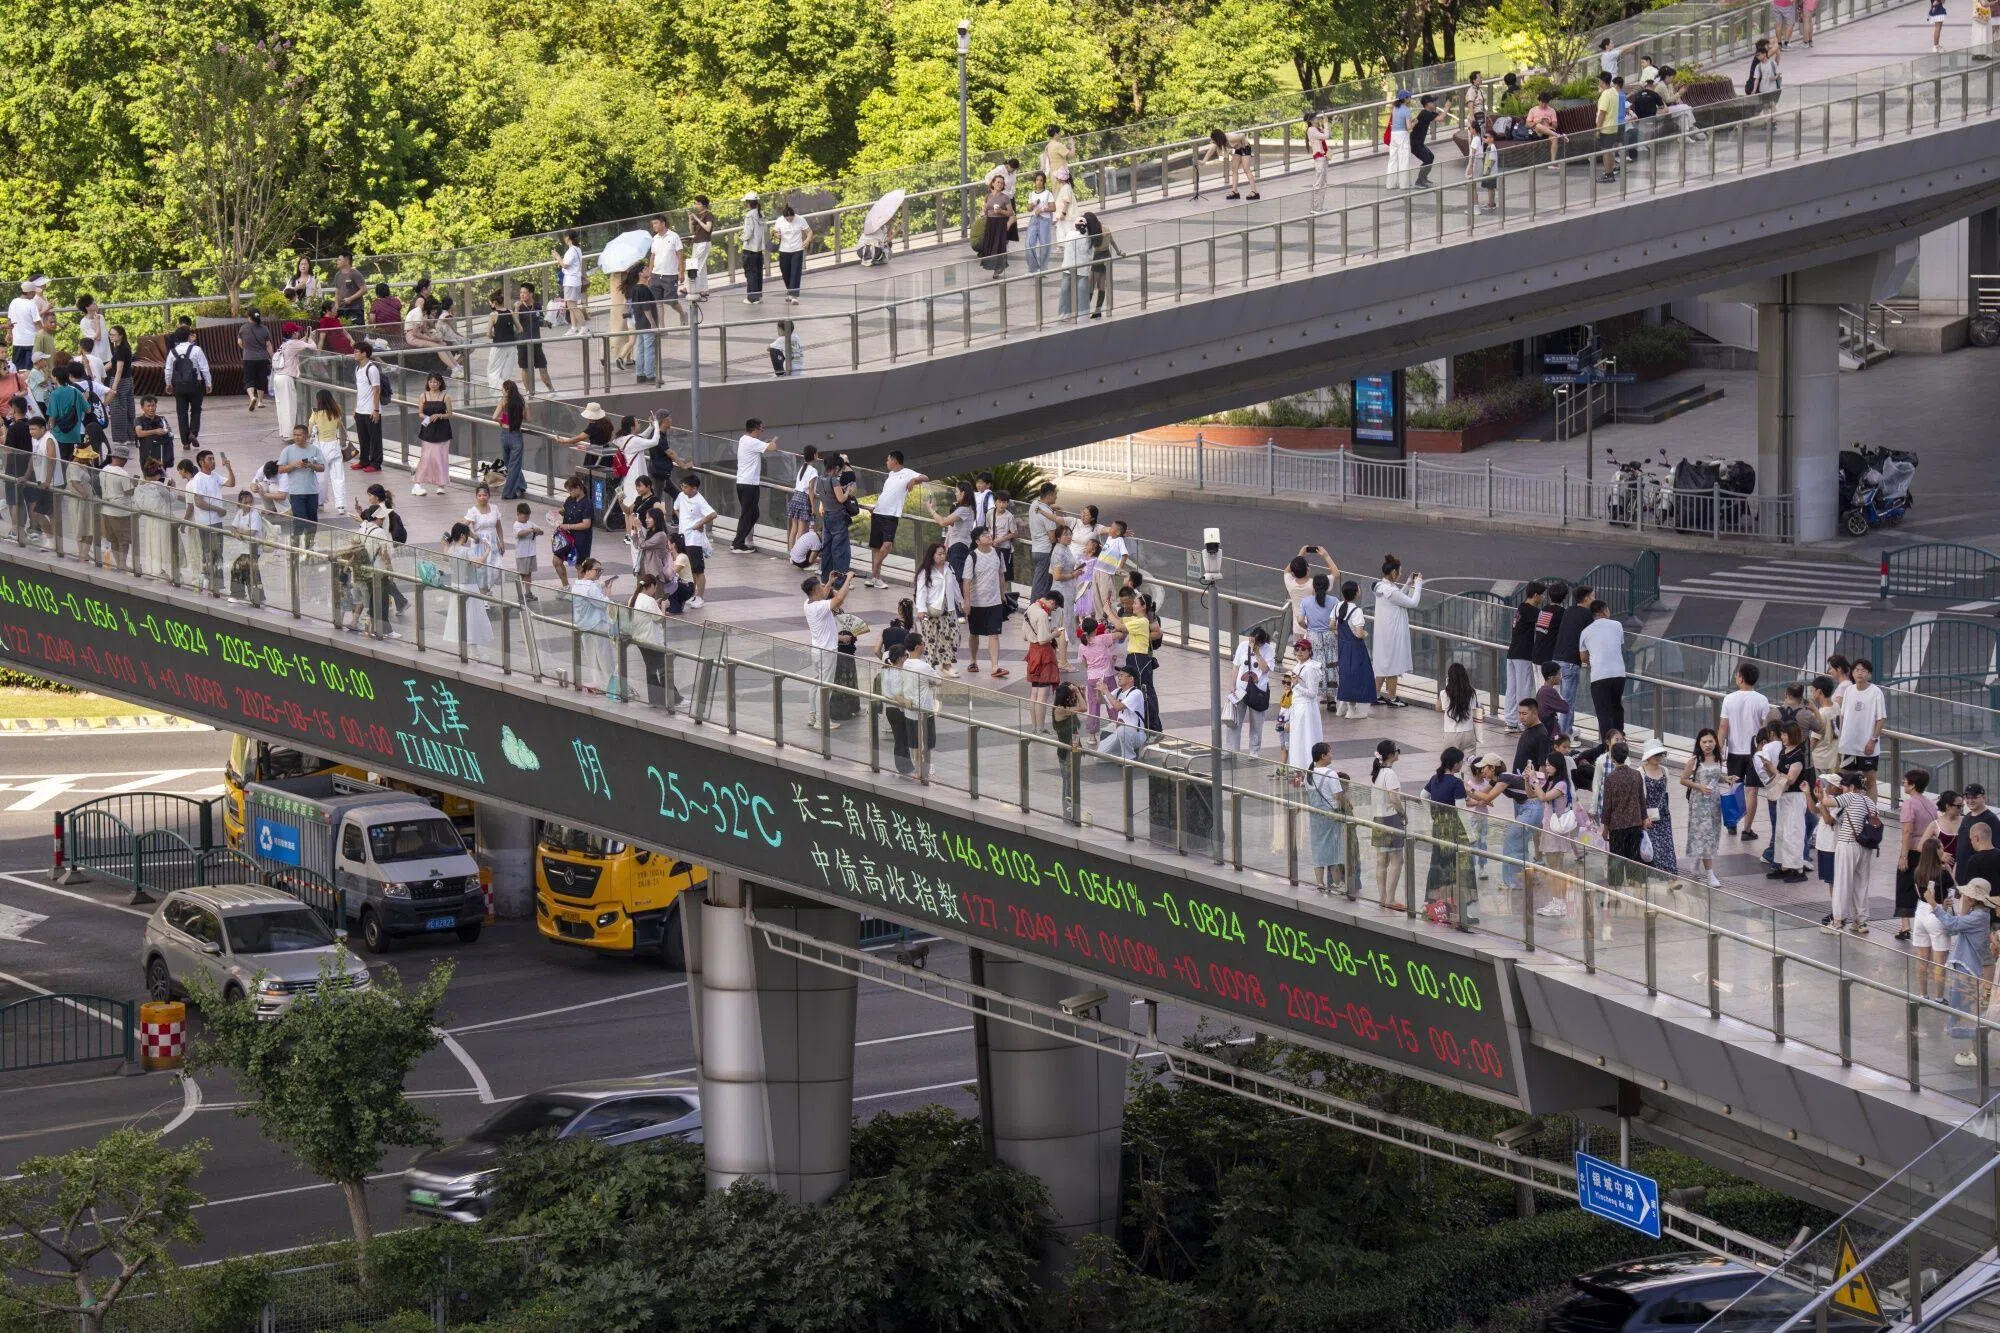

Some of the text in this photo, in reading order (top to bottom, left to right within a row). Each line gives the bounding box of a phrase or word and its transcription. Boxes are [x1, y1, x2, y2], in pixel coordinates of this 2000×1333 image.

[215, 632, 316, 686] 2025-08-15
[320, 660, 374, 701] 00:00
[236, 687, 336, 741] 2025-08-15
[339, 715, 394, 757] 00:00
[403, 679, 469, 746] 天津
[396, 731, 485, 785] TIANJIN
[572, 735, 612, 800] 阴
[1258, 919, 1398, 988] 2025-08-15
[1407, 961, 1482, 1012] 00:00
[1279, 982, 1419, 1054] 2025-08-15
[1428, 1026, 1503, 1080] 00:00
[1592, 1170, 1634, 1200] 银城中路
